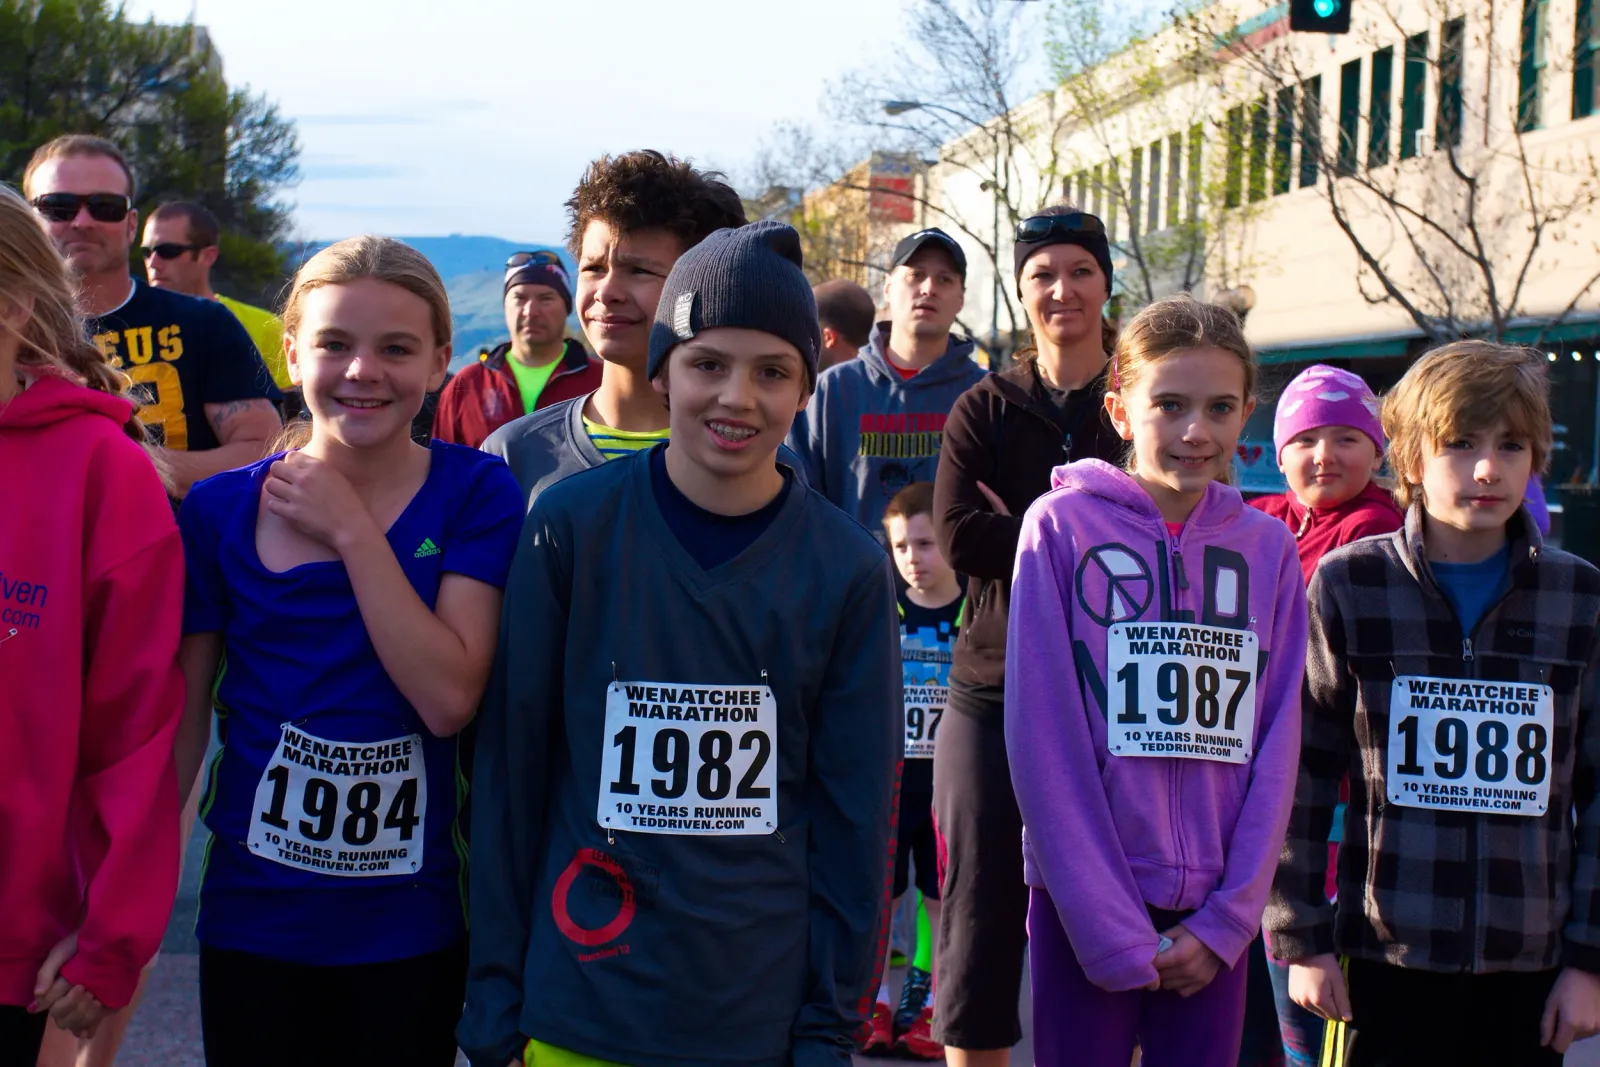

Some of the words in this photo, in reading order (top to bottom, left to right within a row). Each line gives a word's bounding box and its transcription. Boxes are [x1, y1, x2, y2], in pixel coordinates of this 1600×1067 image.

[414, 548, 441, 558] adidas
[1125, 627, 1244, 648] WENATCHEE
[1129, 641, 1241, 663] MARATHON
[625, 686, 761, 706] WENATCHEE
[904, 687, 948, 697] ENATCH
[904, 696, 947, 705] ARATH
[1117, 662, 1251, 731] 1987
[1408, 680, 1540, 702] WENATCHEE
[628, 702, 758, 723] MARATHON
[1410, 695, 1536, 716] MARATHON
[906, 707, 944, 741] 97
[284, 728, 413, 761] WENATCHEE
[1124, 731, 1142, 741] 10
[1145, 731, 1191, 742] YEARS
[1195, 733, 1243, 749] RUNNING
[1140, 742, 1231, 757] TEDDRIVEN.COM
[1396, 715, 1547, 786] 1988
[282, 744, 410, 776] MARATHON
[609, 725, 771, 801] 1982
[1402, 782, 1418, 793] 10
[1422, 783, 1469, 796] YEARS
[1473, 786, 1537, 801] RUNNING
[1417, 793, 1522, 810] TEDDRIVEN.COM
[260, 764, 420, 846] 1984
[615, 802, 633, 814] 10
[637, 804, 689, 818] YEARS
[694, 806, 762, 818] RUNNING
[631, 816, 745, 830] TEDDRIVEN.COM
[264, 832, 281, 845] 10
[285, 838, 333, 859] YEARS
[338, 848, 408, 862] RUNNING
[277, 848, 390, 872] TEDDRIVEN.COM
